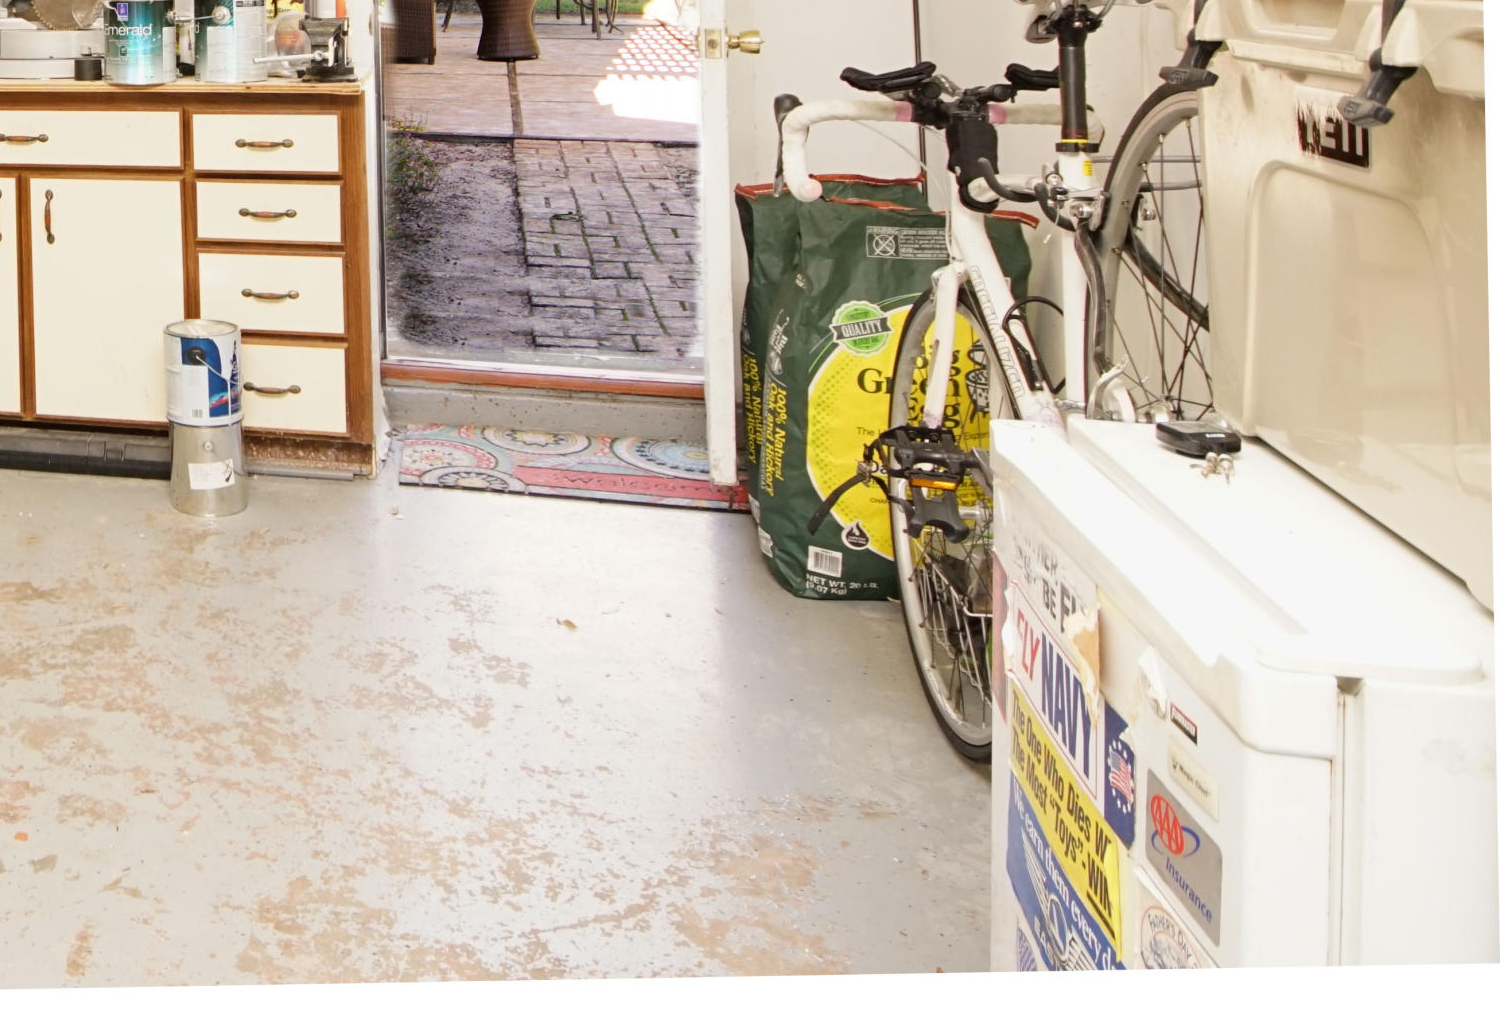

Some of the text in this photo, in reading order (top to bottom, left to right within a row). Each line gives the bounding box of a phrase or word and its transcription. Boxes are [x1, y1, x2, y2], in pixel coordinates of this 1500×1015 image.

[104, 23, 153, 36] Emerald
[841, 320, 883, 343] QUALITY
[764, 382, 778, 497] Oak and Hickory
[774, 387, 788, 481] 100% Natural
[806, 573, 827, 586] NET
[1042, 577, 1057, 620] BE
[1016, 608, 1041, 680] FLY
[1041, 627, 1092, 781] NAVY
[1012, 689, 1025, 732] The
[1026, 716, 1042, 759] One
[1044, 743, 1065, 795] Who
[1067, 784, 1091, 843] Dies
[1012, 727, 1025, 768] The
[1026, 756, 1048, 813] Most
[1087, 869, 1112, 919] WIN
[1151, 796, 1185, 855] AAA
[1025, 812, 1044, 862] earn
[1045, 850, 1070, 904] them
[1070, 900, 1102, 962] every
[1164, 853, 1213, 925] Insurance
